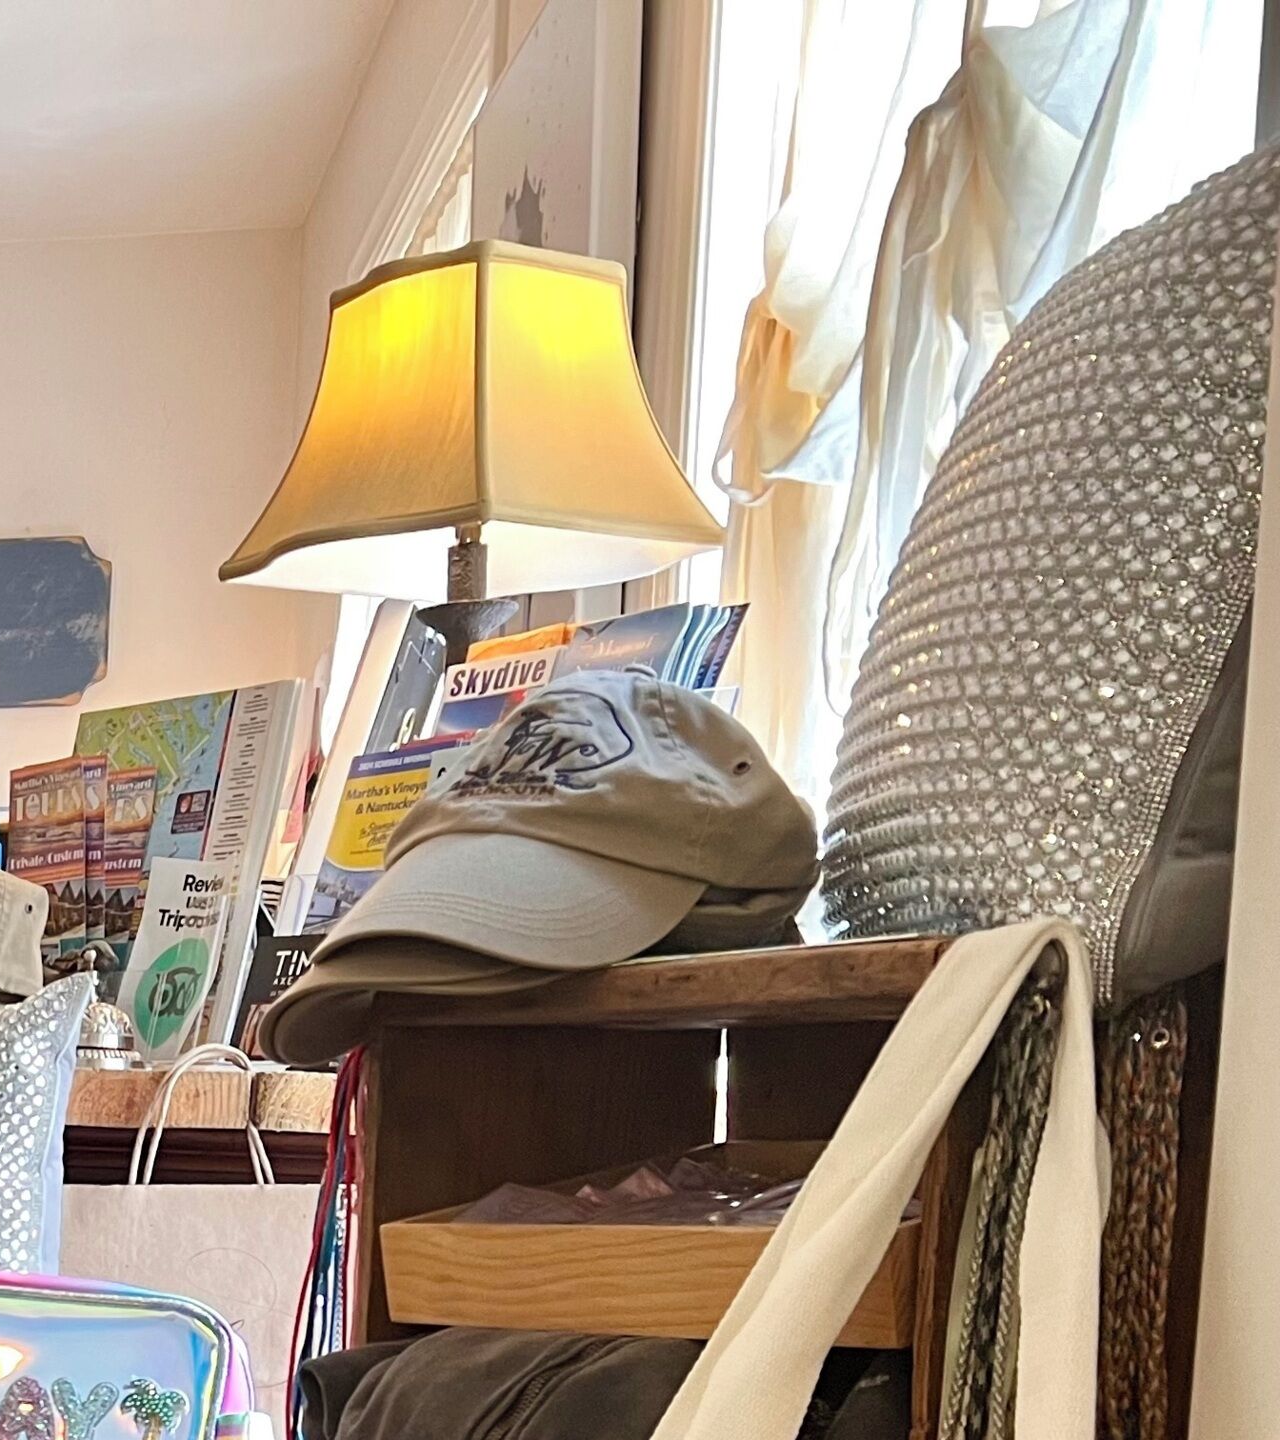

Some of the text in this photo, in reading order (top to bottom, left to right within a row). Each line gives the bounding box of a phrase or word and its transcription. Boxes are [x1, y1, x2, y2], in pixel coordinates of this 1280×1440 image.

[450, 658, 547, 697] Skydive
[346, 784, 391, 801] Martha's
[392, 780, 428, 797] Vineya
[182, 873, 225, 893] Revie
